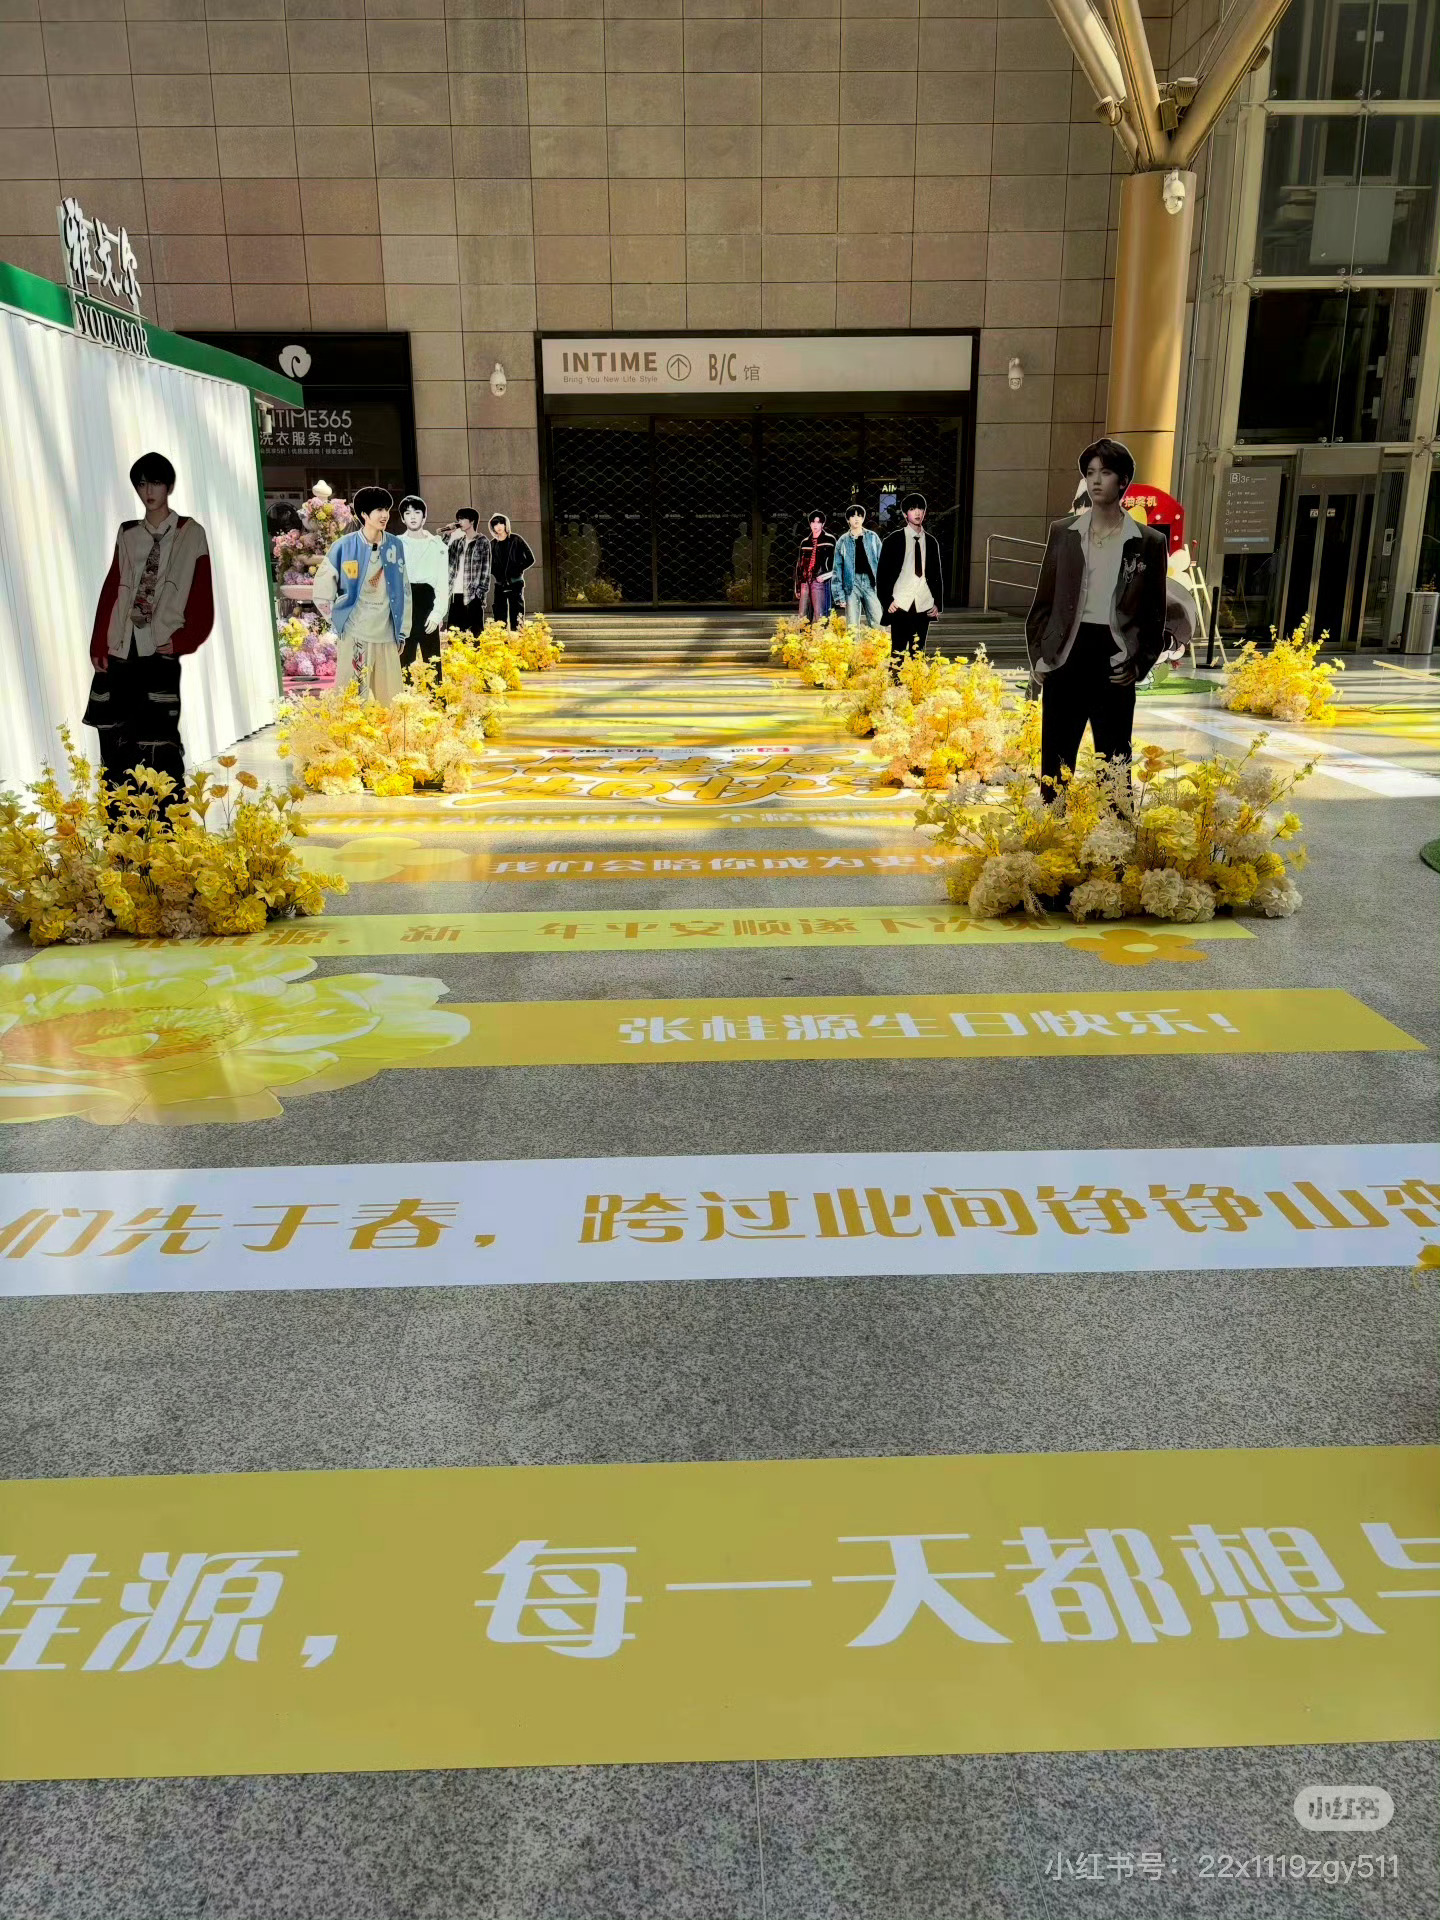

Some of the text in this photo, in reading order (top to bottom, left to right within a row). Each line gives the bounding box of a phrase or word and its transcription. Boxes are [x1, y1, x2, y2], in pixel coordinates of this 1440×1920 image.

[75, 301, 151, 358] YOUNGOR
[562, 352, 658, 373] INTIME
[708, 352, 761, 385] B/C 馆
[563, 375, 658, 385] Bring You New Life Style
[259, 431, 353, 446] 洗衣服务中心
[617, 1009, 1241, 1044] 张桂源生日快乐！
